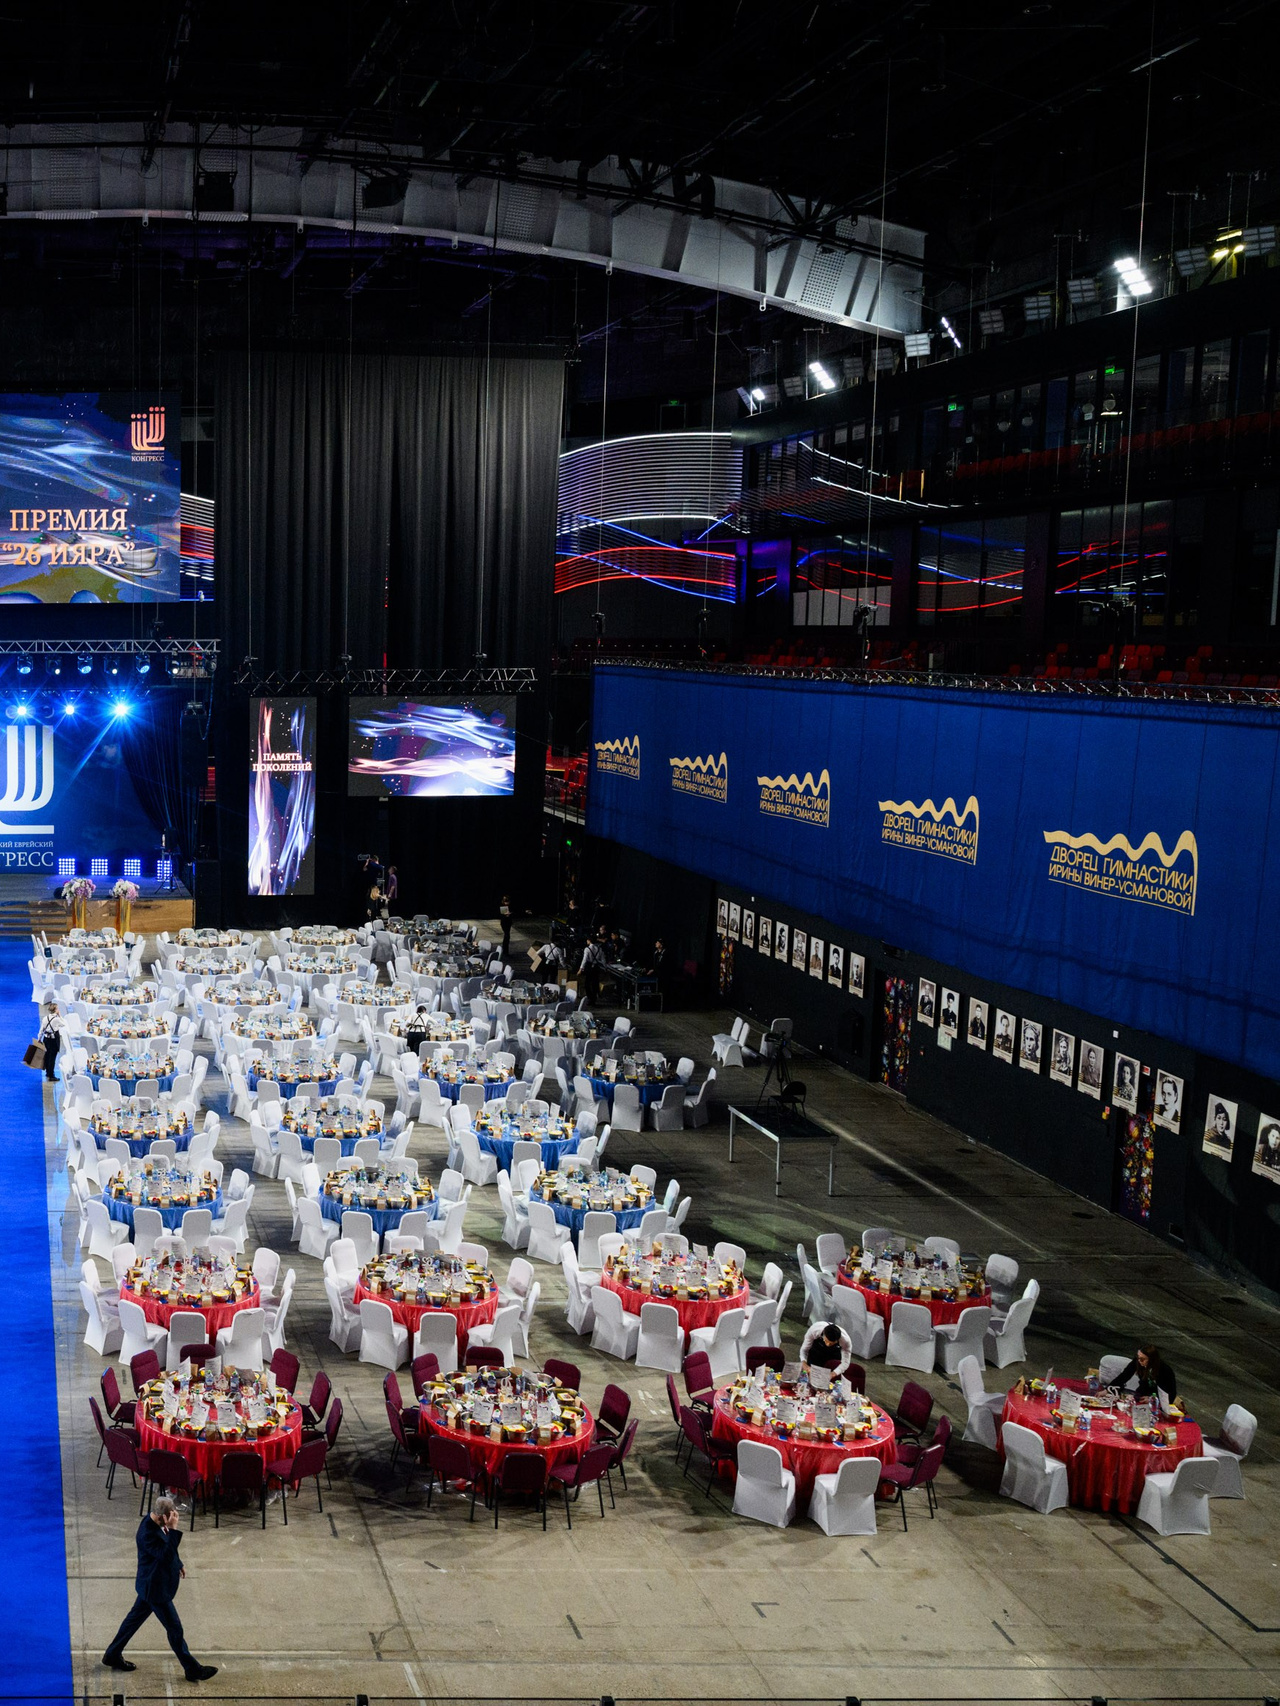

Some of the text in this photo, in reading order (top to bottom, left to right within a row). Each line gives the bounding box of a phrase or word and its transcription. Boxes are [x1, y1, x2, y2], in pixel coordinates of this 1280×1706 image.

[10, 508, 128, 532] ПРЕМИЯ
[252, 762, 312, 771] ПОКОЛЕНИЙ
[263, 753, 302, 761] ПАМЯТЬ
[761, 788, 784, 802] ДВОРЕЦ
[883, 813, 976, 847] ДВОРЕЦ ГИМНАСТИКИ
[14, 840, 54, 848] ЕВРЕЙСКИЙ
[882, 828, 974, 860] ИРИНЫ ВИНЕР-УСМАНОВОЙ
[1050, 846, 1194, 893] ДВОРЕЦ ГИМНАСТИКИ
[1048, 863, 1191, 910] ИРИНЫ ВИНЕР-УСМАНОВОЙ
